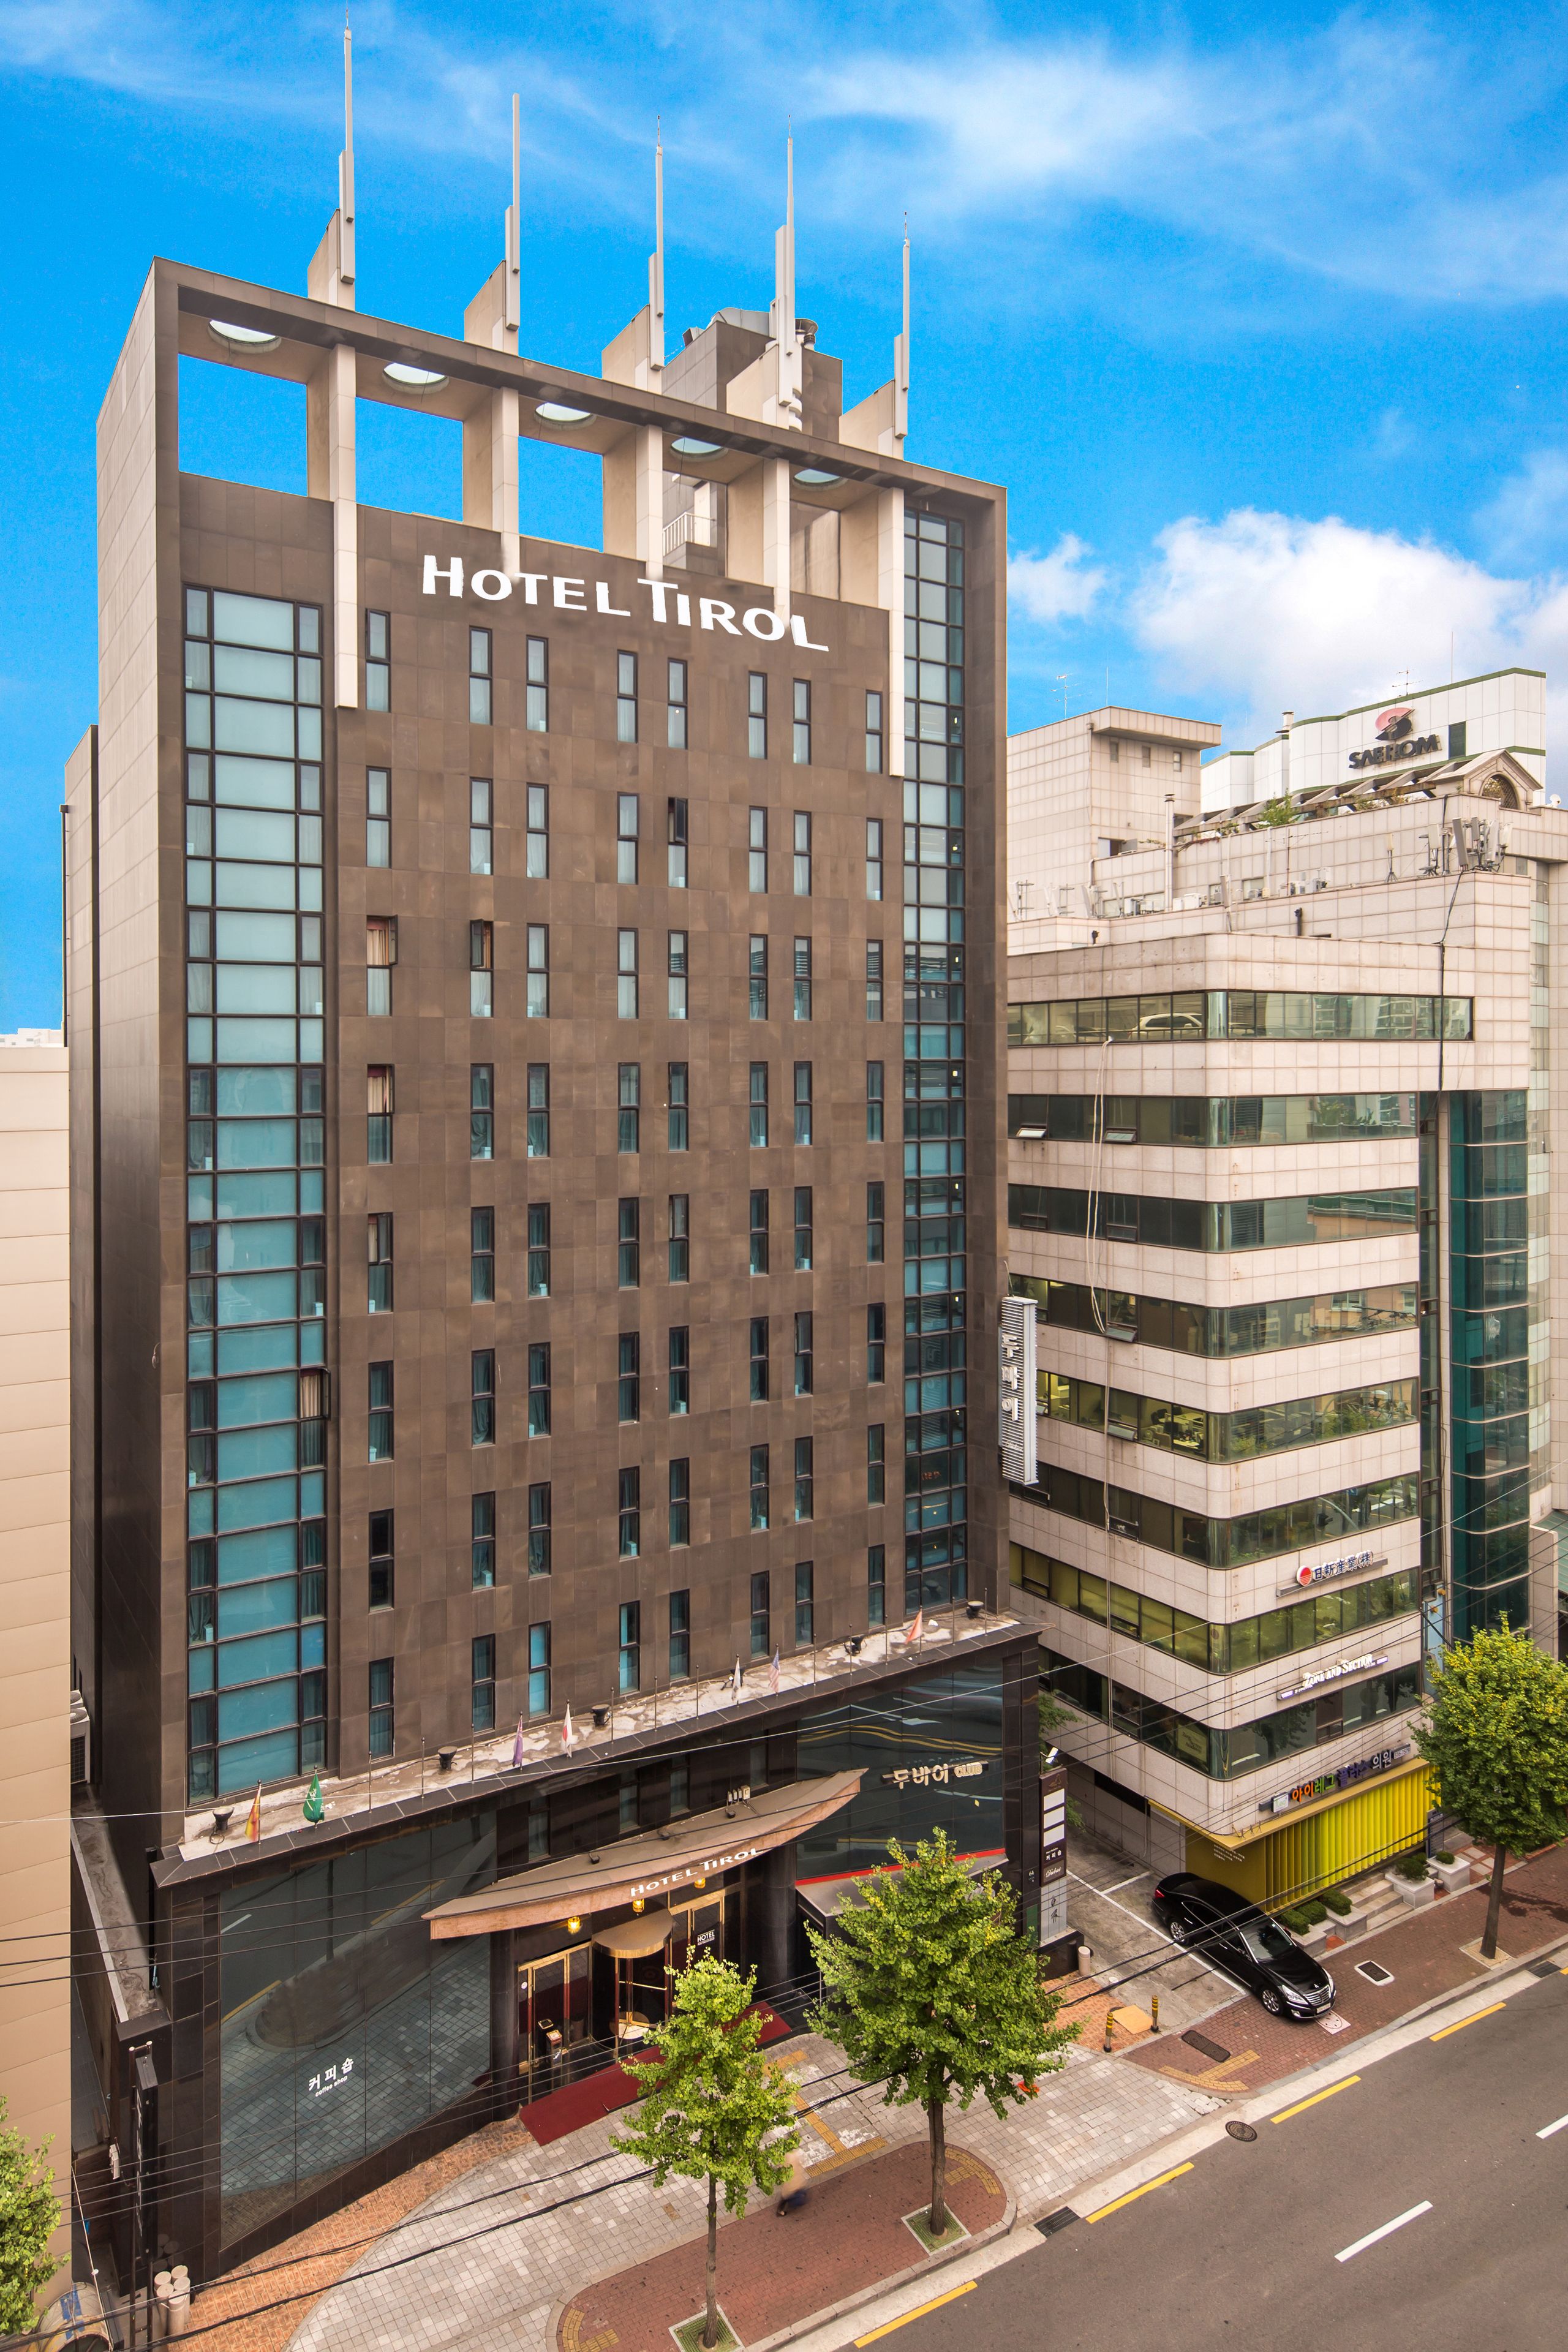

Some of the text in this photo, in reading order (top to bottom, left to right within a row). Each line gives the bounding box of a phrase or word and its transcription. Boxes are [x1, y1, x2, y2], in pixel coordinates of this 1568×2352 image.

[423, 554, 829, 652] HOTEL TIROL
[1349, 734, 1439, 769] SAEROM
[892, 1762, 982, 1789] 두바이 CLUB
[630, 1848, 764, 1897] HOTEL TIROL
[697, 1931, 715, 1942] HOTEL
[315, 2075, 348, 2097] coffee shop
